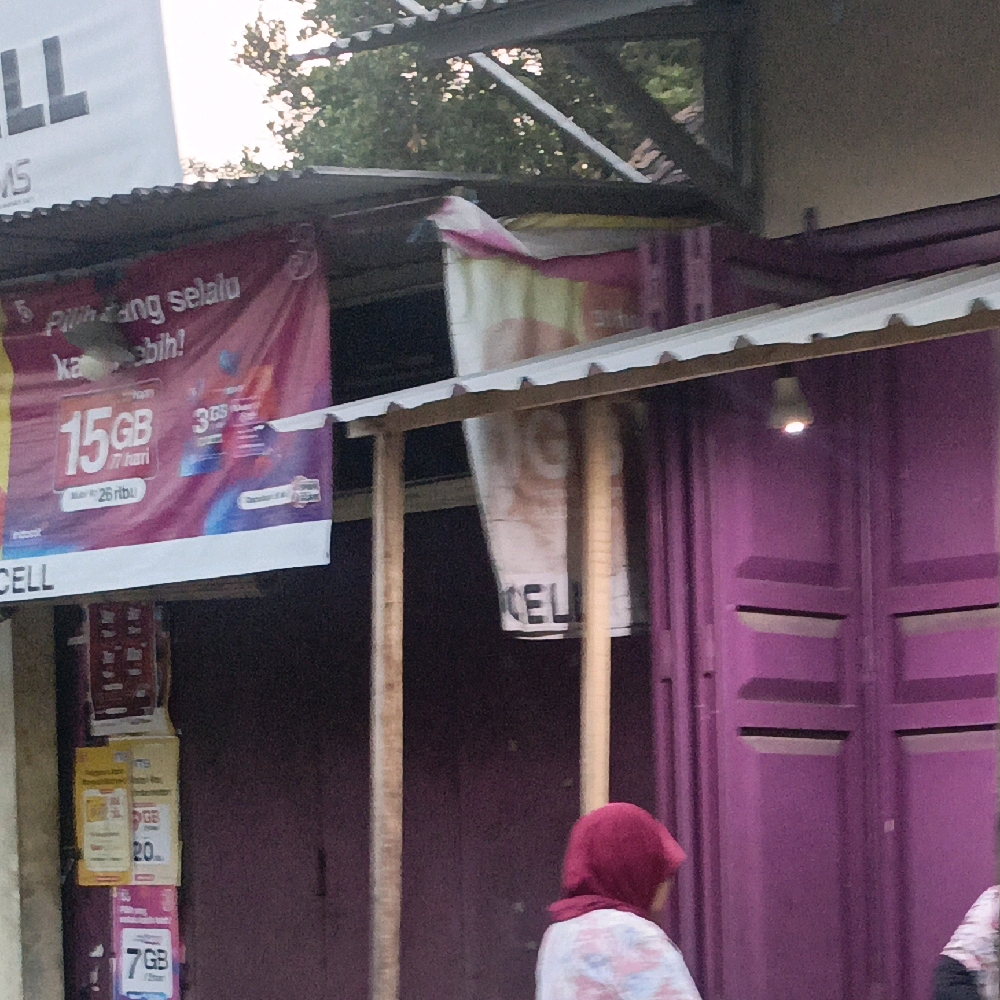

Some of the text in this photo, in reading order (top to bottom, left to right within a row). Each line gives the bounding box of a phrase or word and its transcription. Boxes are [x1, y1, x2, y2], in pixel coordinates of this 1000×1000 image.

[0, 36, 89, 138] LL
[167, 273, 241, 312] selalu
[124, 447, 150, 467] hari
